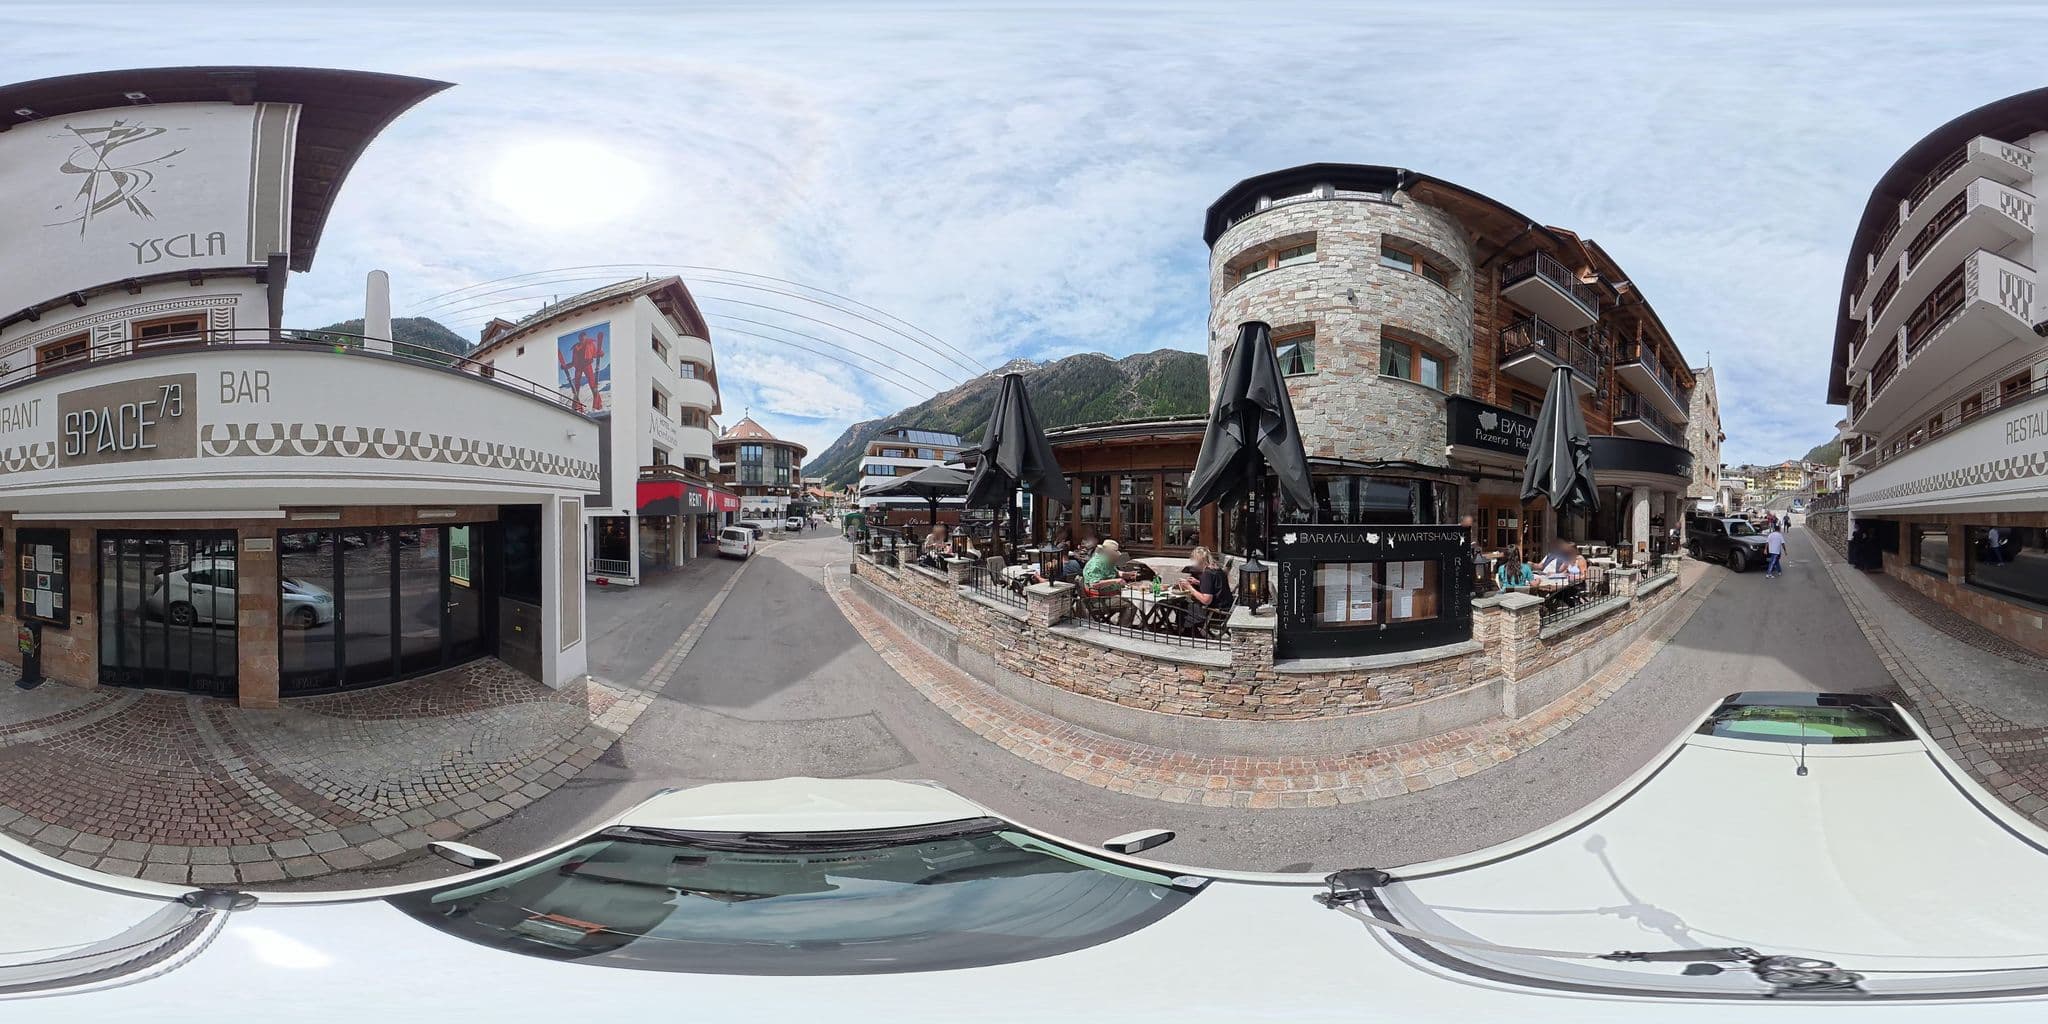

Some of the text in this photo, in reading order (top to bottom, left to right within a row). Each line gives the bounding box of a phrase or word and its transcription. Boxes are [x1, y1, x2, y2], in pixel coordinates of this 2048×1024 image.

[128, 231, 226, 265] YSCLA
[220, 370, 270, 404] BAR
[65, 383, 182, 456] SPACE 73
[1475, 428, 1508, 445] Pizzeria
[1398, 532, 1458, 542] WIARTSHAUS
